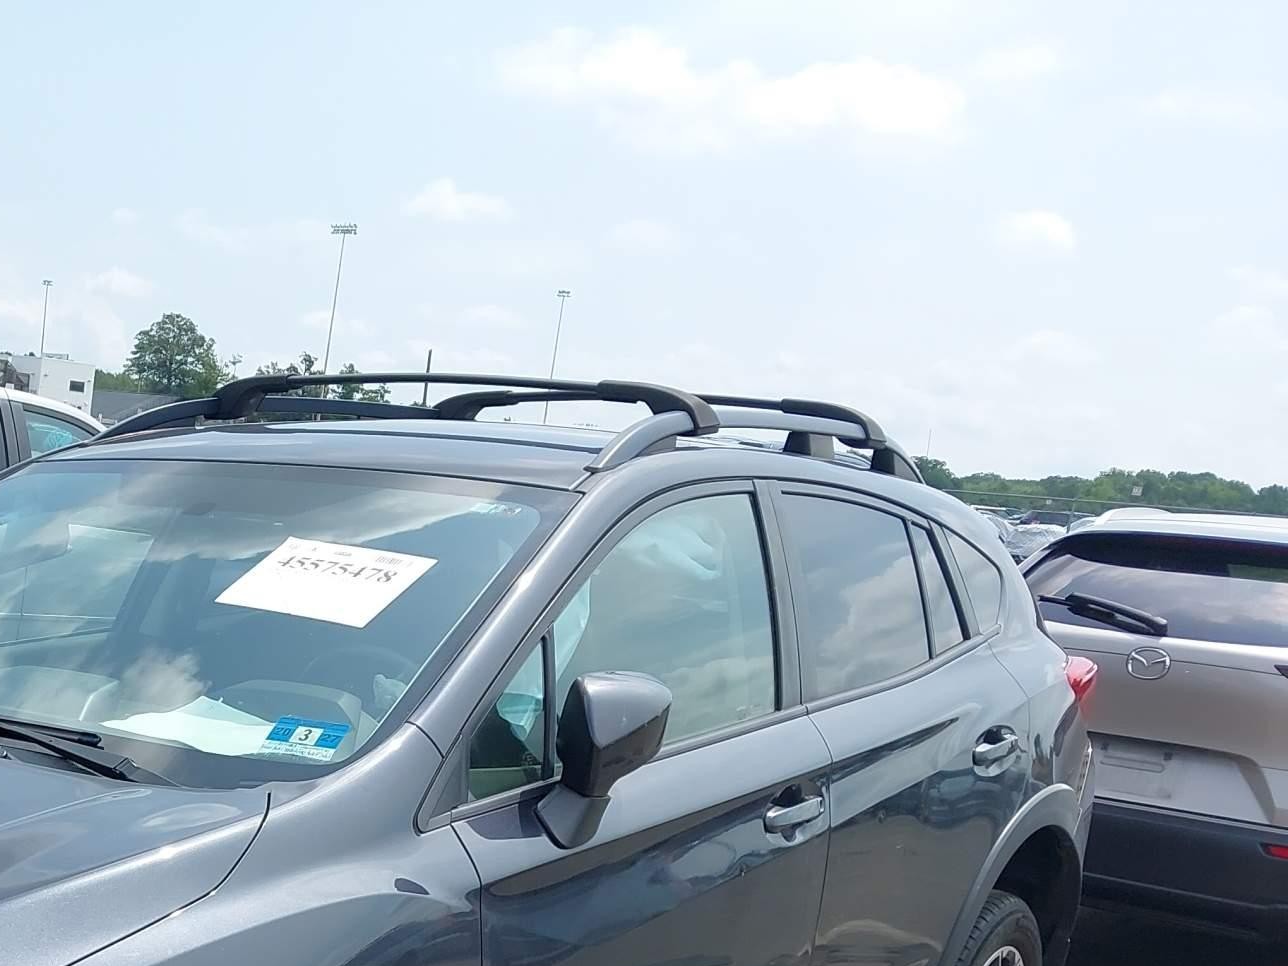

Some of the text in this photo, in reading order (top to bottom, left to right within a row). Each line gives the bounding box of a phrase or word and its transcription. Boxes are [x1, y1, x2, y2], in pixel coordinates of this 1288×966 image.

[277, 555, 398, 583] 45575478
[272, 726, 292, 737] 20
[298, 728, 313, 742] 3
